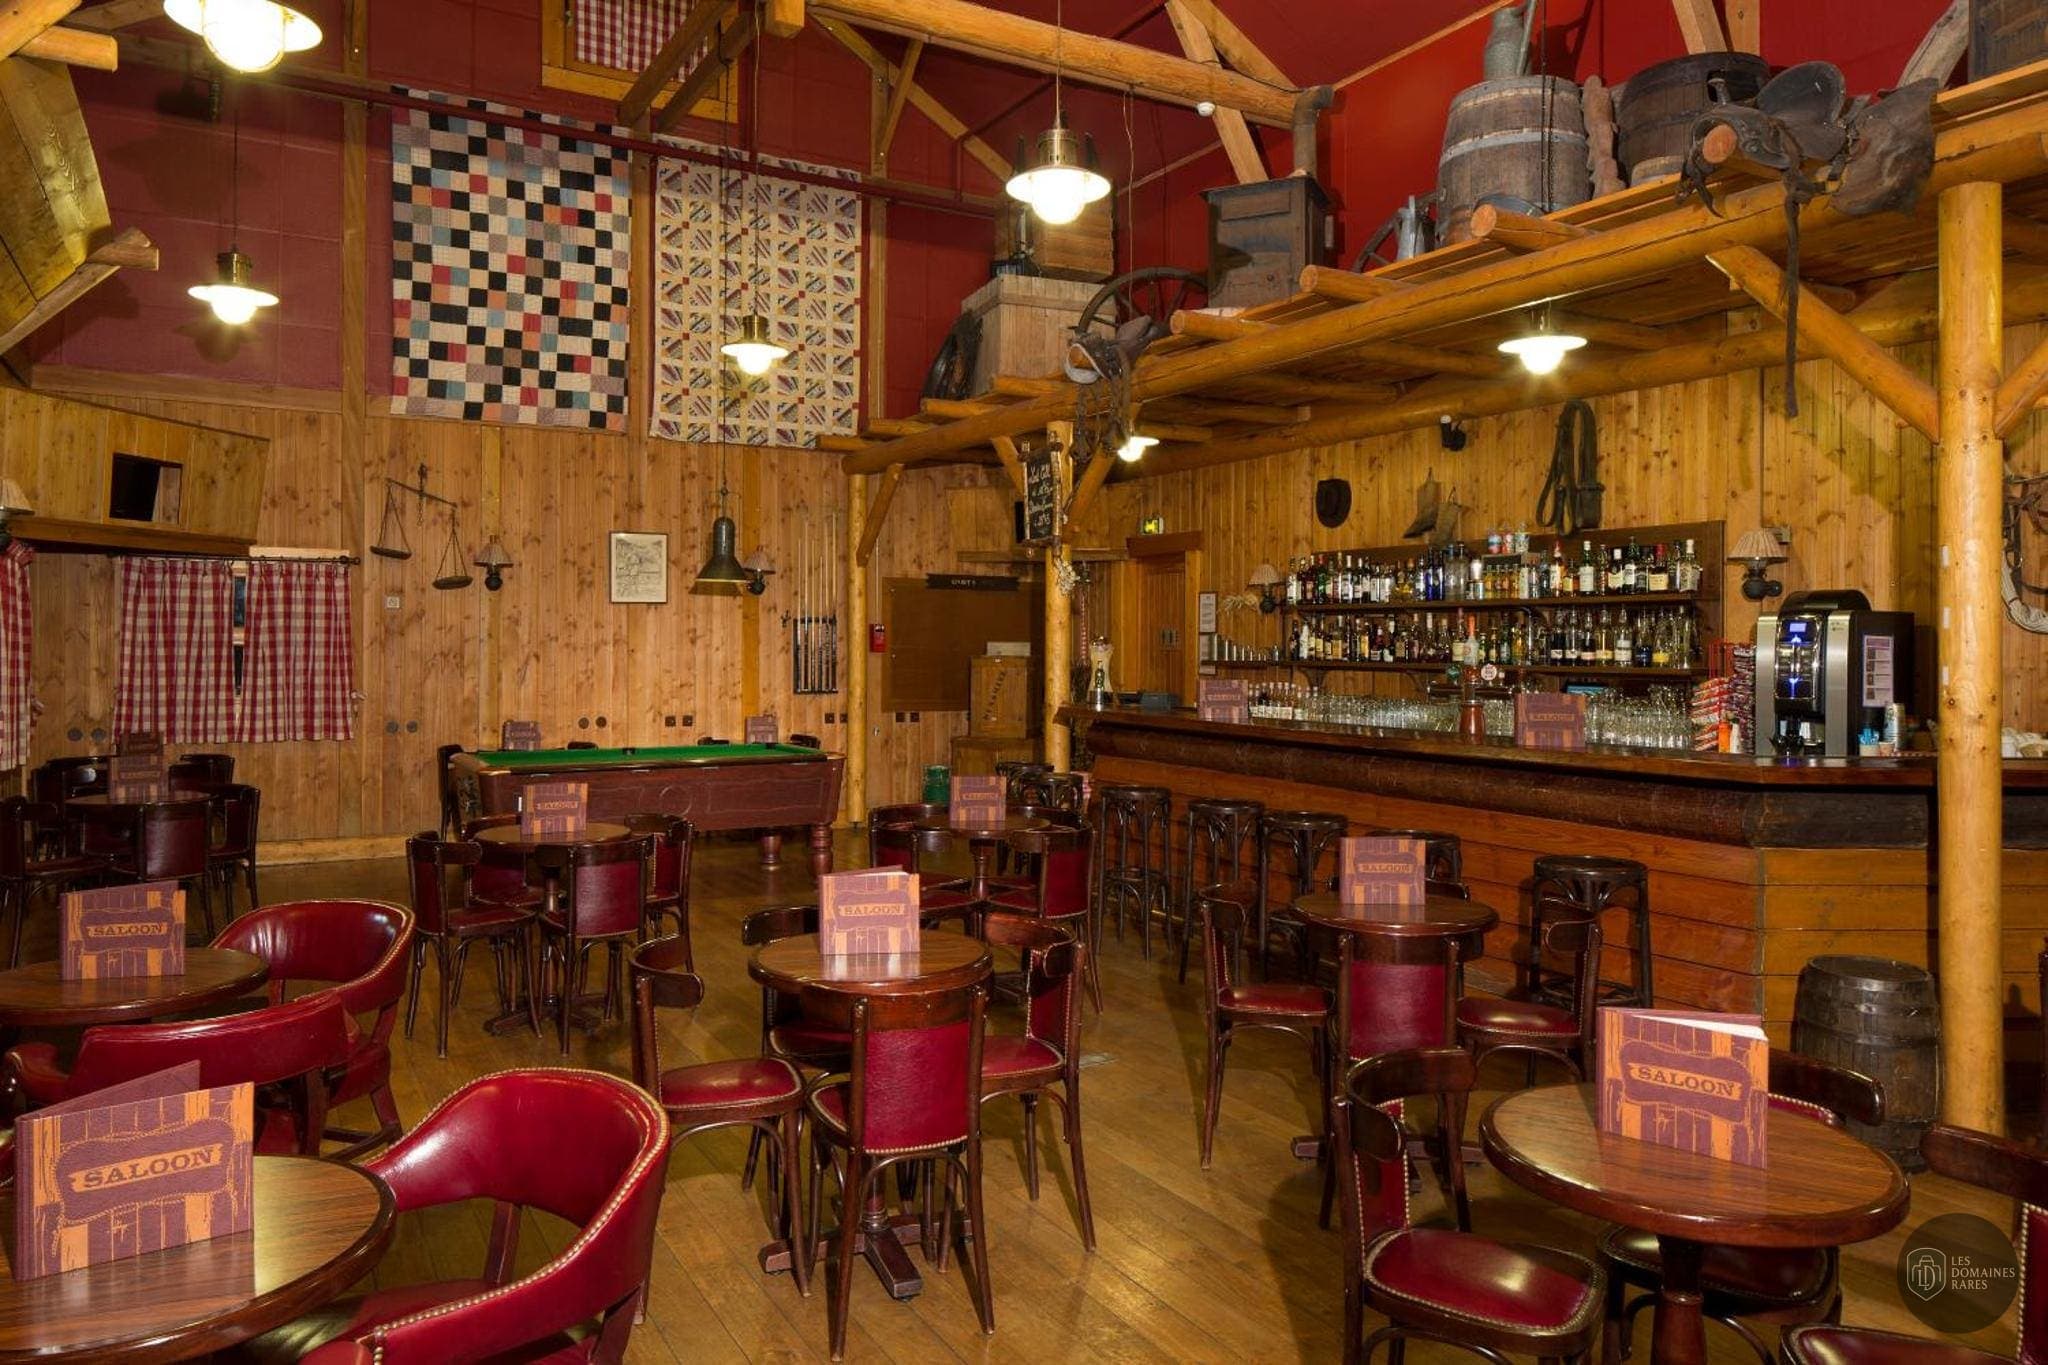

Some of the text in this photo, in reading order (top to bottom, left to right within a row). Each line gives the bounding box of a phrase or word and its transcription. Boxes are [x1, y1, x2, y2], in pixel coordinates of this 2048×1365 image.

[844, 905, 901, 915] SALOON
[94, 924, 162, 936] SALOON
[1638, 1066, 1735, 1097] SALOON
[84, 1150, 212, 1188] SALOON
